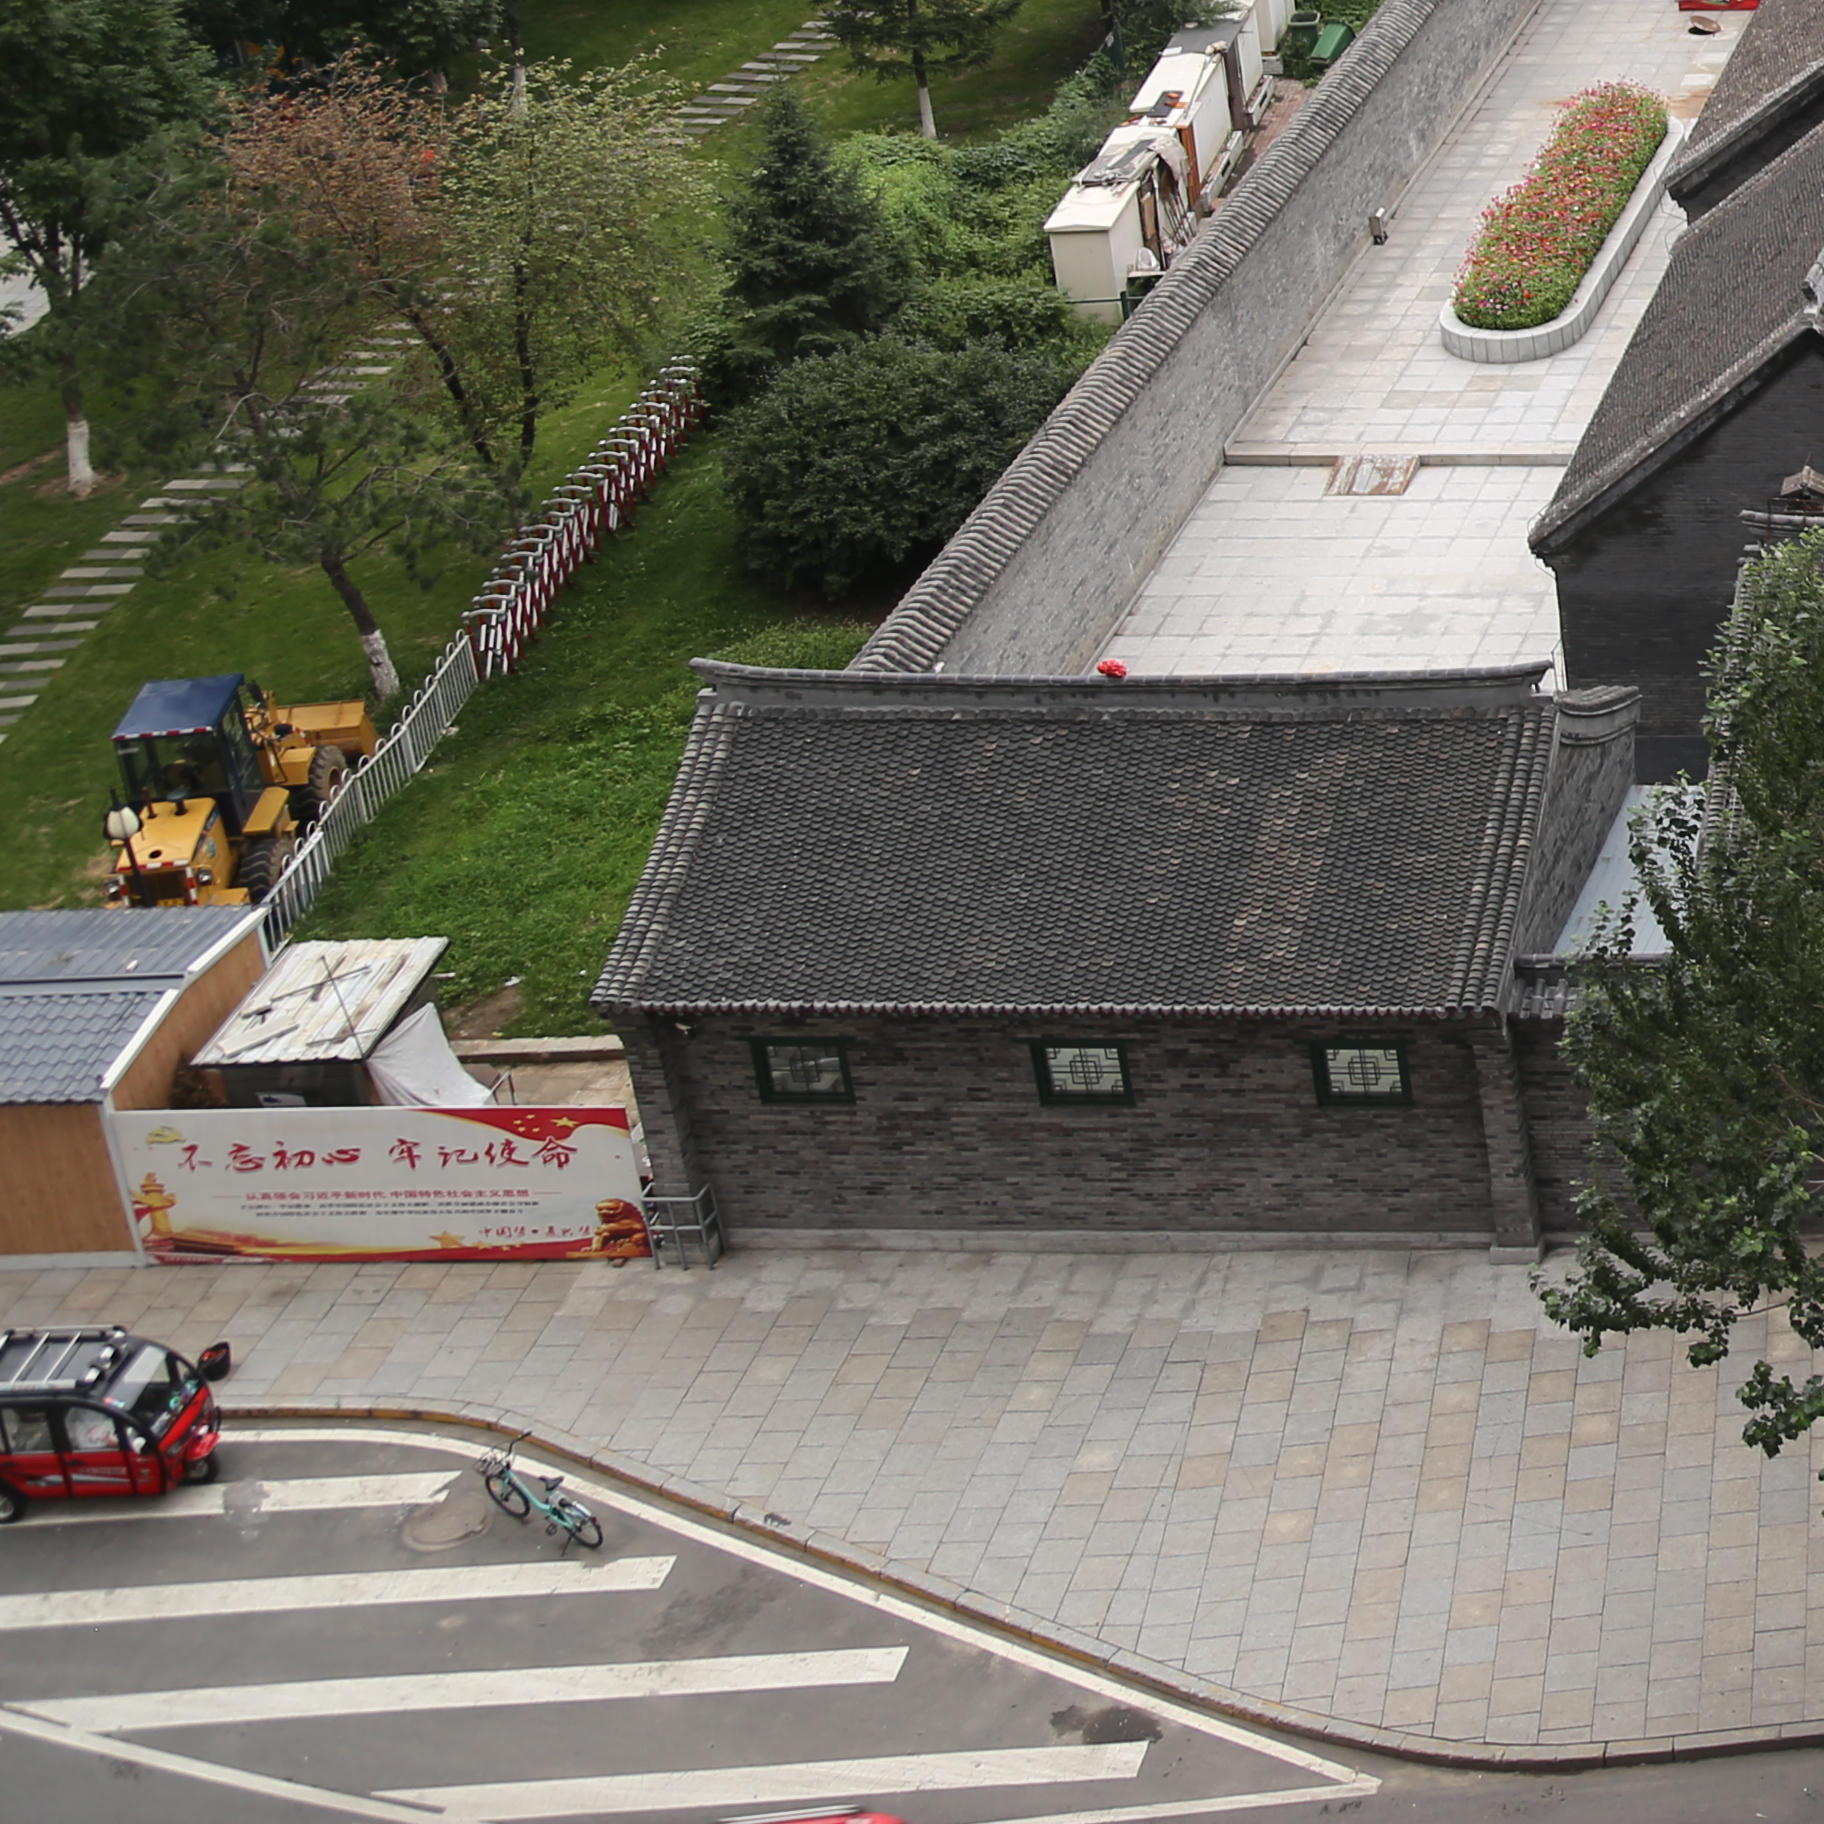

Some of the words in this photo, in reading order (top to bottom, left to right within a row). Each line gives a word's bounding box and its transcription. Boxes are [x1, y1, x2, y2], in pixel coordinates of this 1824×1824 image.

[177, 1140, 361, 1172] 不忘初心
[388, 1136, 578, 1169] 牢记使命
